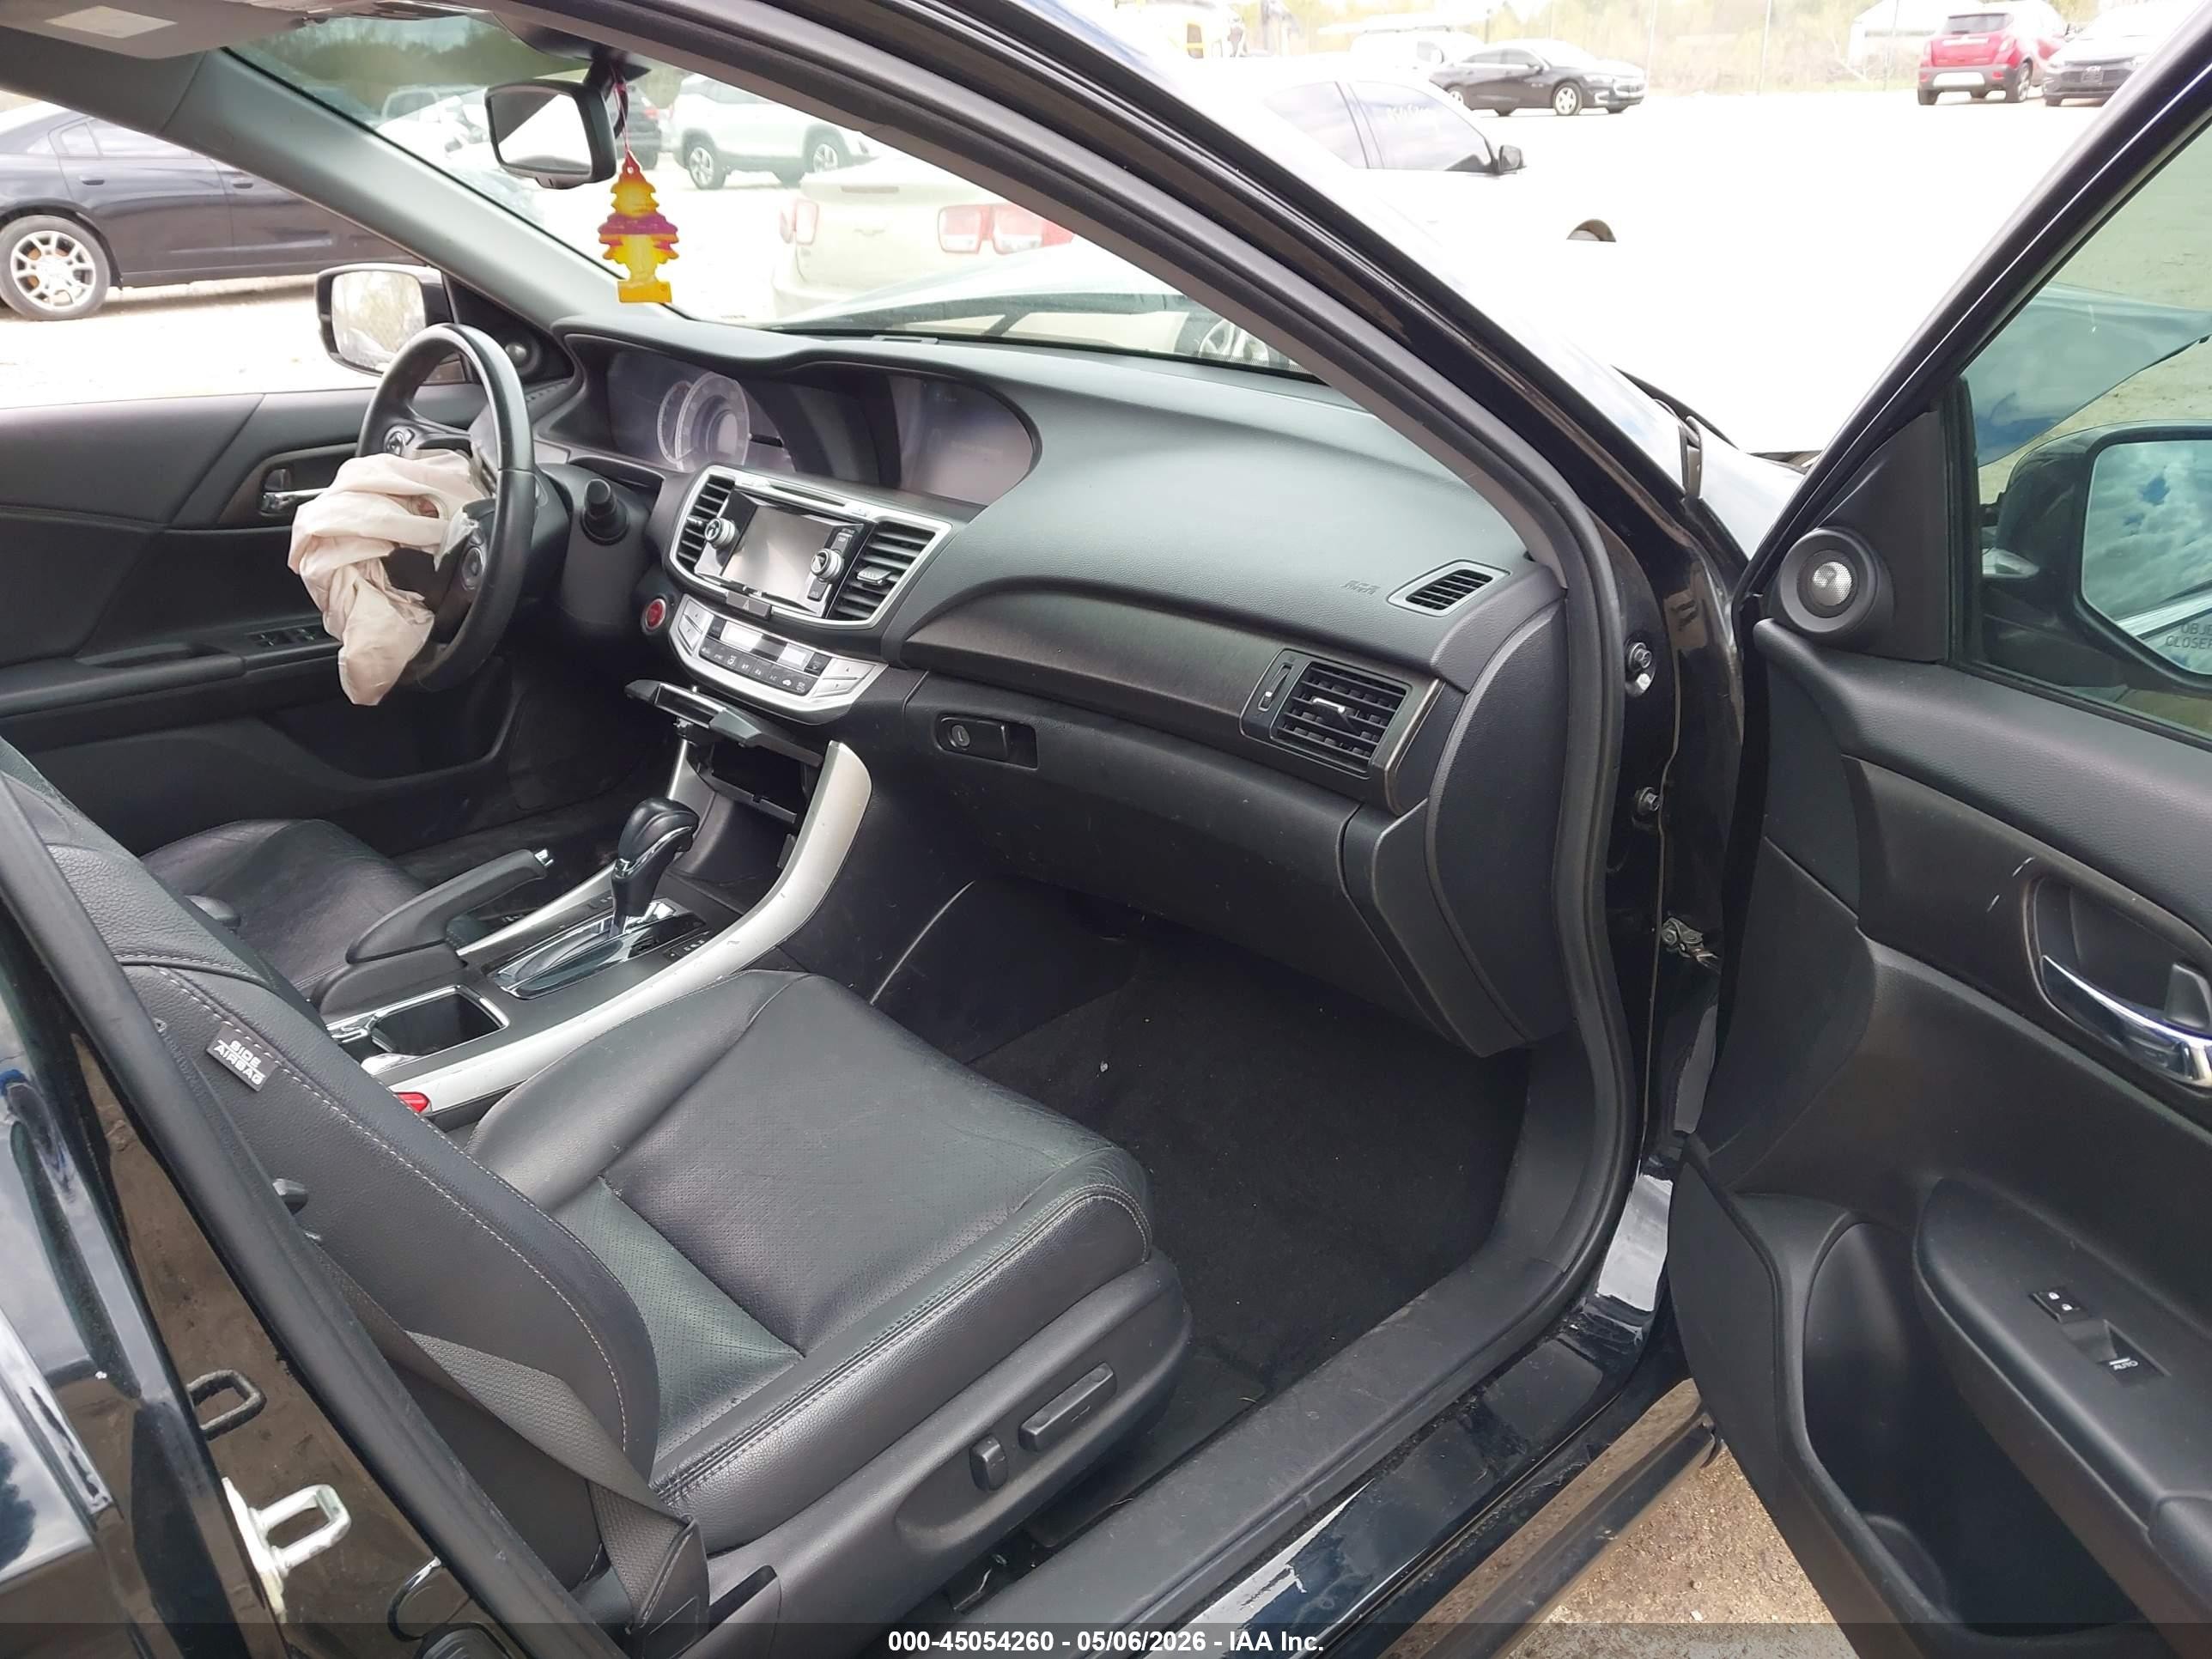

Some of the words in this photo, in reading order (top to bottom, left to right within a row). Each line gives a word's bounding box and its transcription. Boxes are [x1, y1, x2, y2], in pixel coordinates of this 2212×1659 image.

[213, 1044, 264, 1085] AIRBAG
[229, 1040, 262, 1068] SIDE
[2112, 1360, 2139, 1371] AUTO
